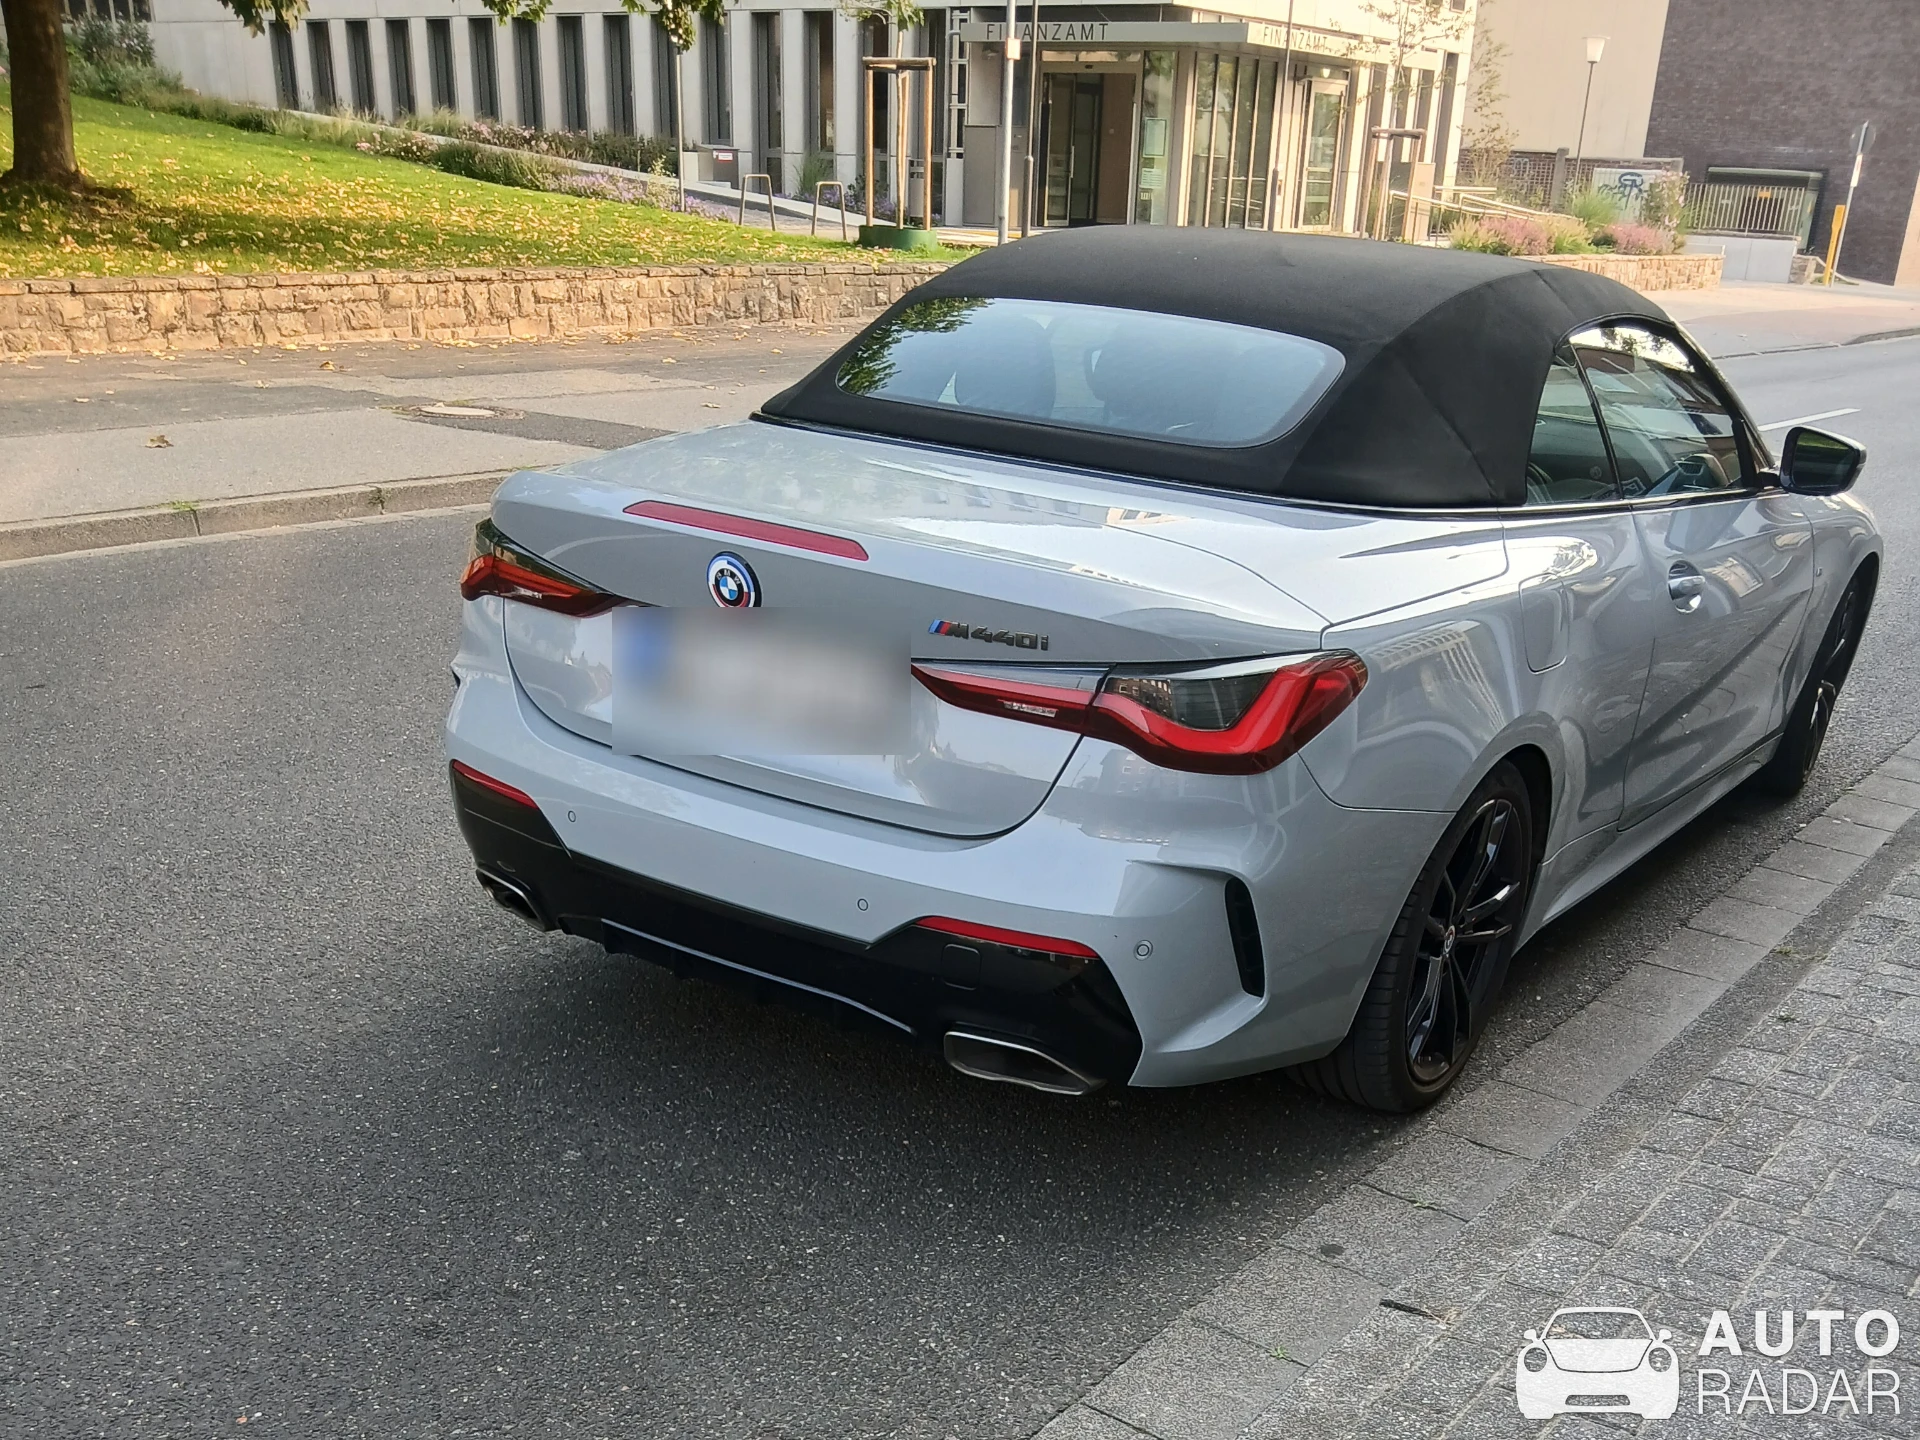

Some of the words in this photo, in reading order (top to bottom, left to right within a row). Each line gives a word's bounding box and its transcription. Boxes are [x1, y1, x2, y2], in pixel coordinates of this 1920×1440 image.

[986, 23, 1109, 41] FIANZAMT
[716, 569, 741, 585] BMW
[945, 621, 1049, 651] M440i
